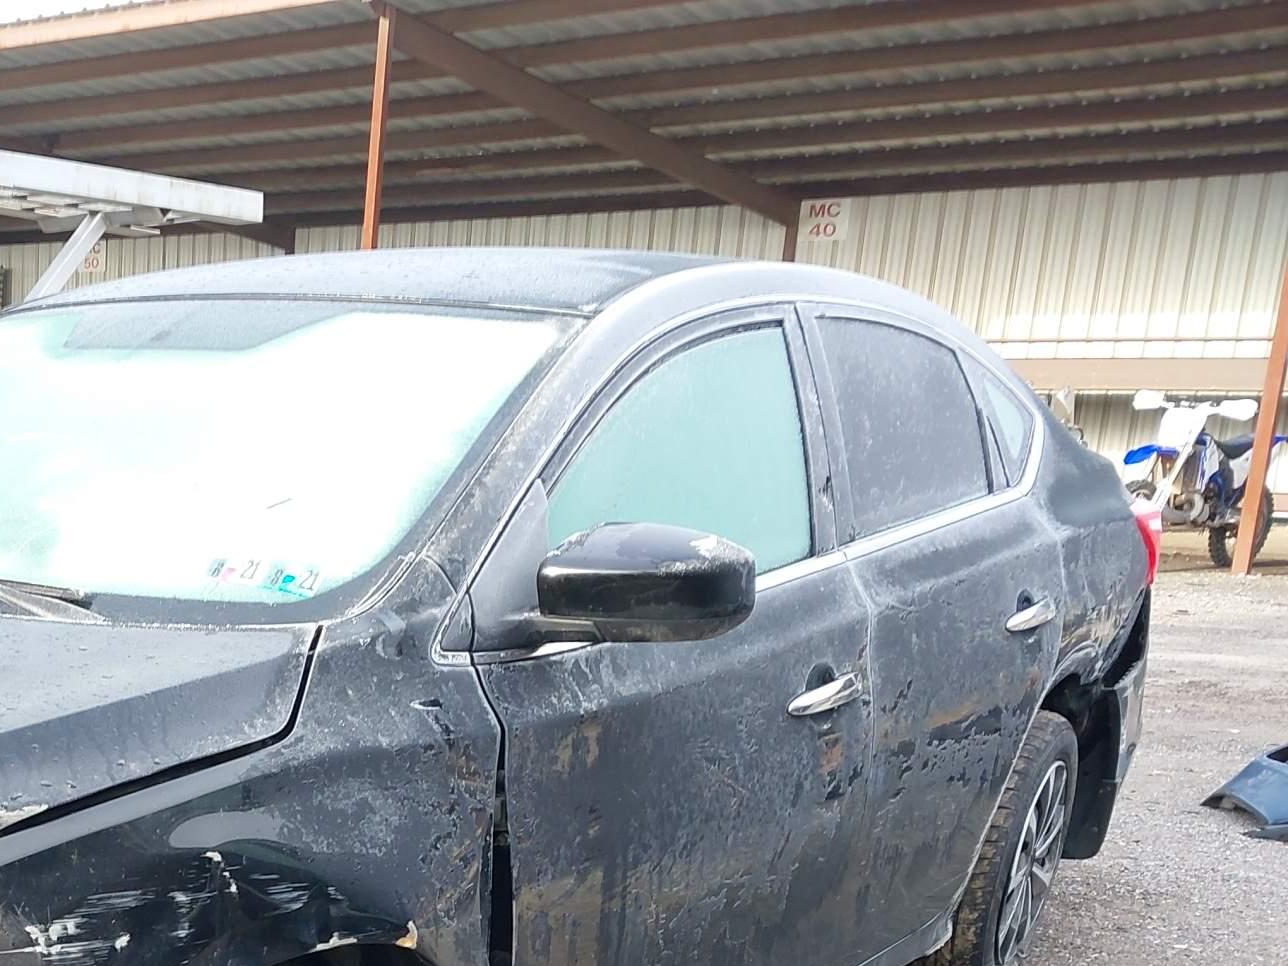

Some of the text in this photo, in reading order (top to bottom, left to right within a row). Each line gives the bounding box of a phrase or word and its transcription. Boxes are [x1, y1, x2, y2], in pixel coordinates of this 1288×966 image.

[808, 202, 841, 219] MC
[808, 222, 837, 238] 40
[83, 256, 99, 269] 50
[298, 569, 320, 591] 21
